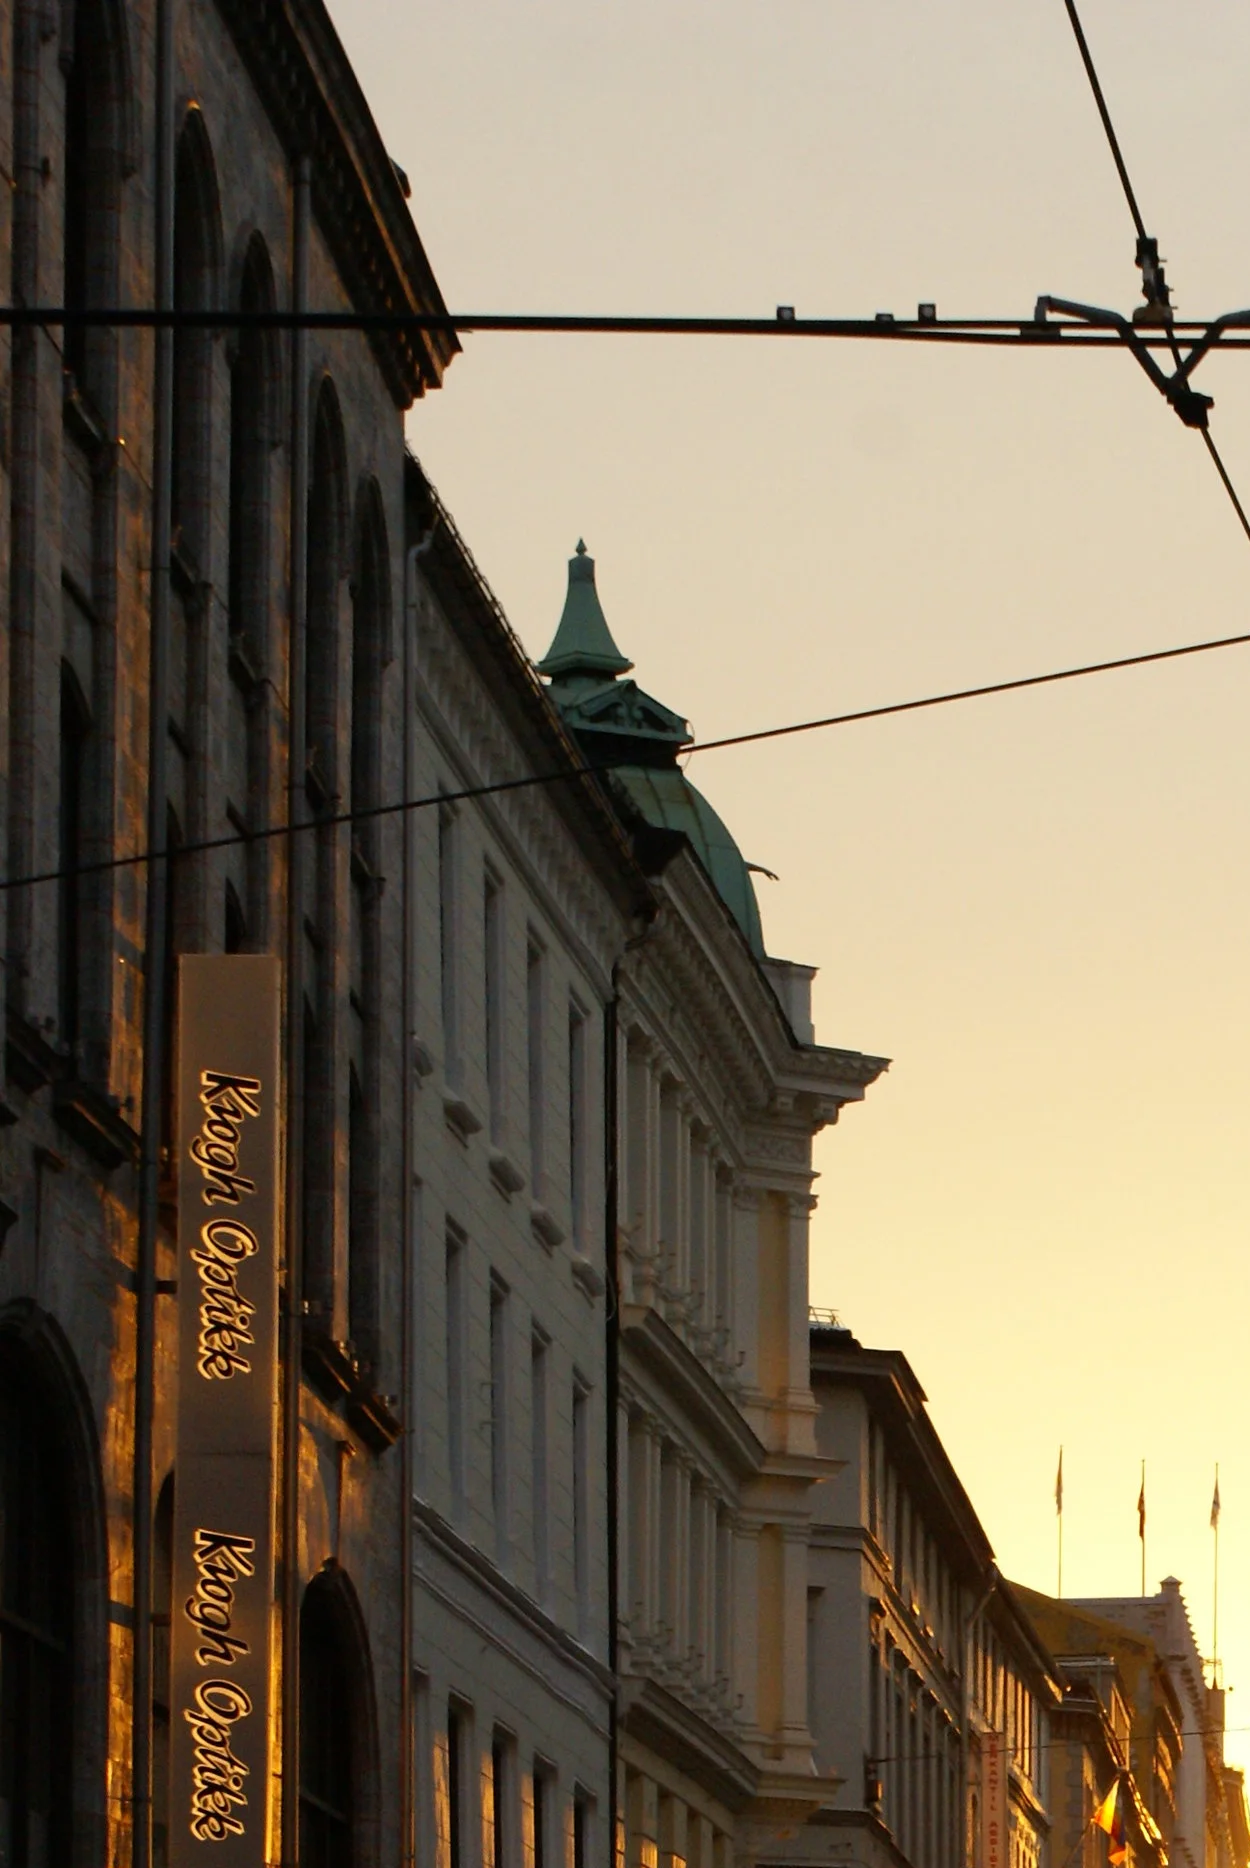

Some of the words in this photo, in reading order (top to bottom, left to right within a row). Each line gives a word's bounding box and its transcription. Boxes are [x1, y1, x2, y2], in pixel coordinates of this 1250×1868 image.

[190, 1069, 261, 1206] Krogh
[190, 1218, 258, 1380] Optikk
[184, 1528, 255, 1667] Krogh
[183, 1679, 252, 1842] Optikk
